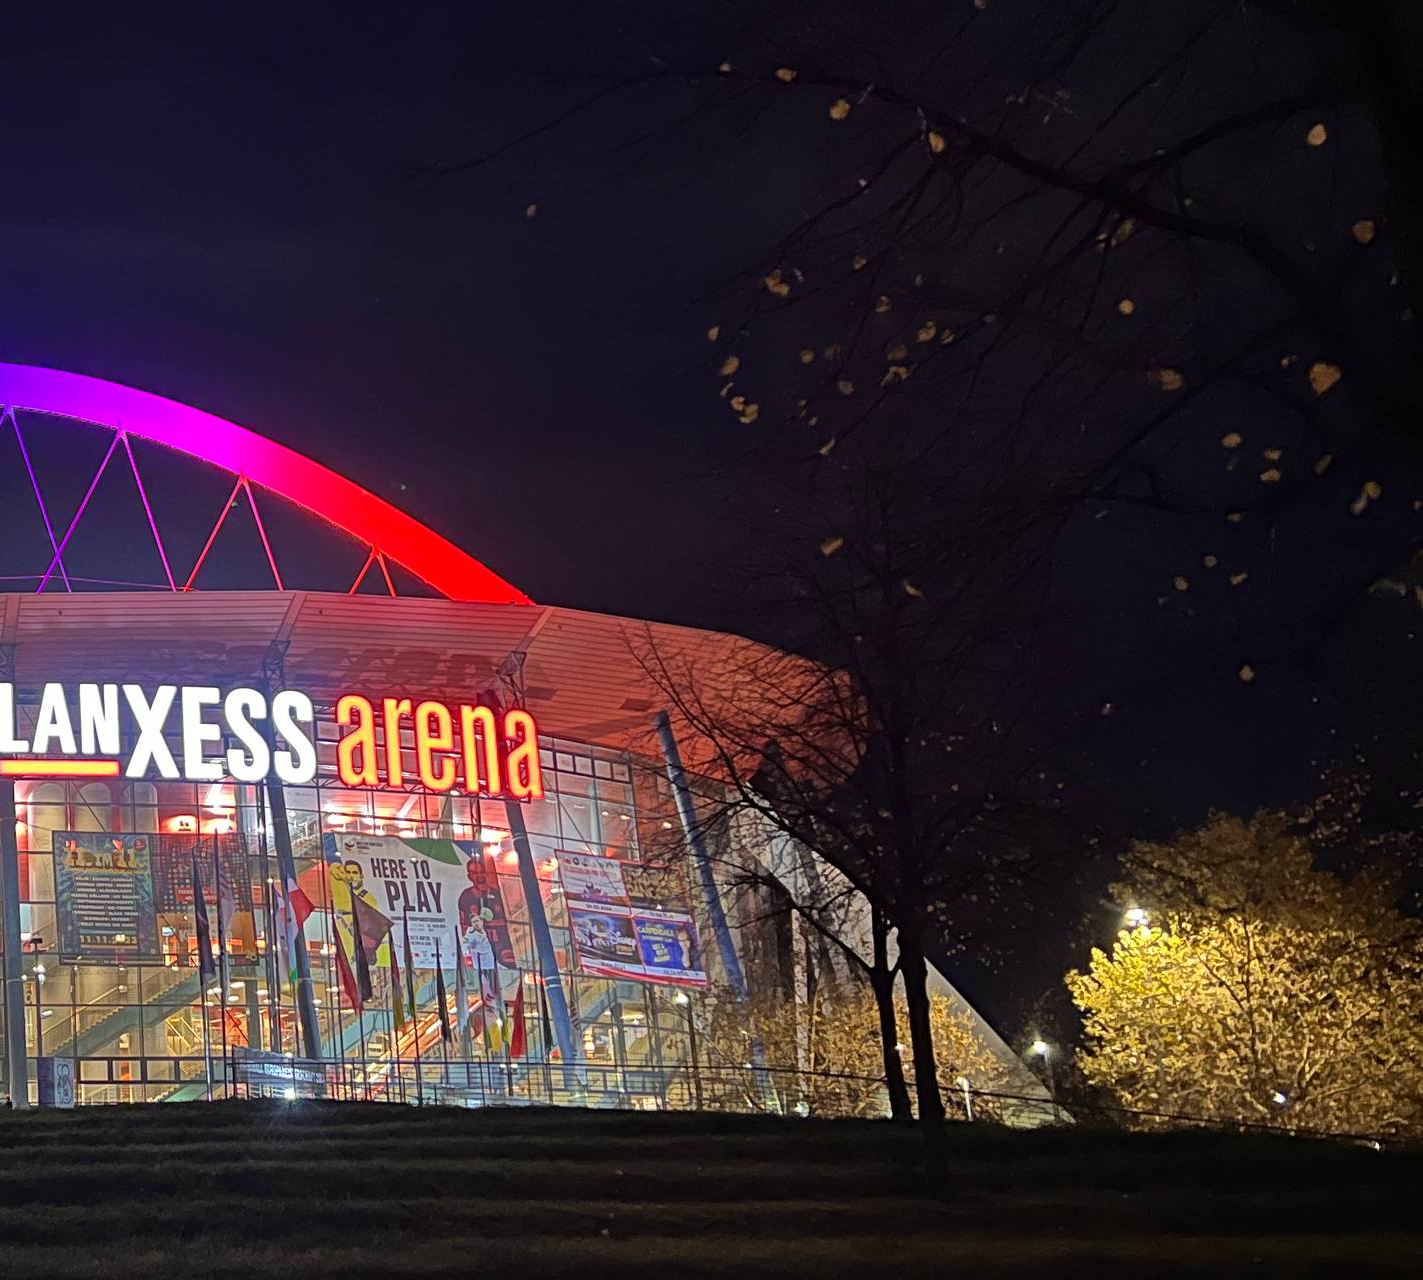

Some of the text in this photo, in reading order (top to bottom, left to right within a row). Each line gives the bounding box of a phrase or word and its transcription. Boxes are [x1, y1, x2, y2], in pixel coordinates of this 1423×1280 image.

[336, 694, 545, 800] arena
[370, 857, 431, 880] HERE TO
[384, 880, 442, 914] PLAY
